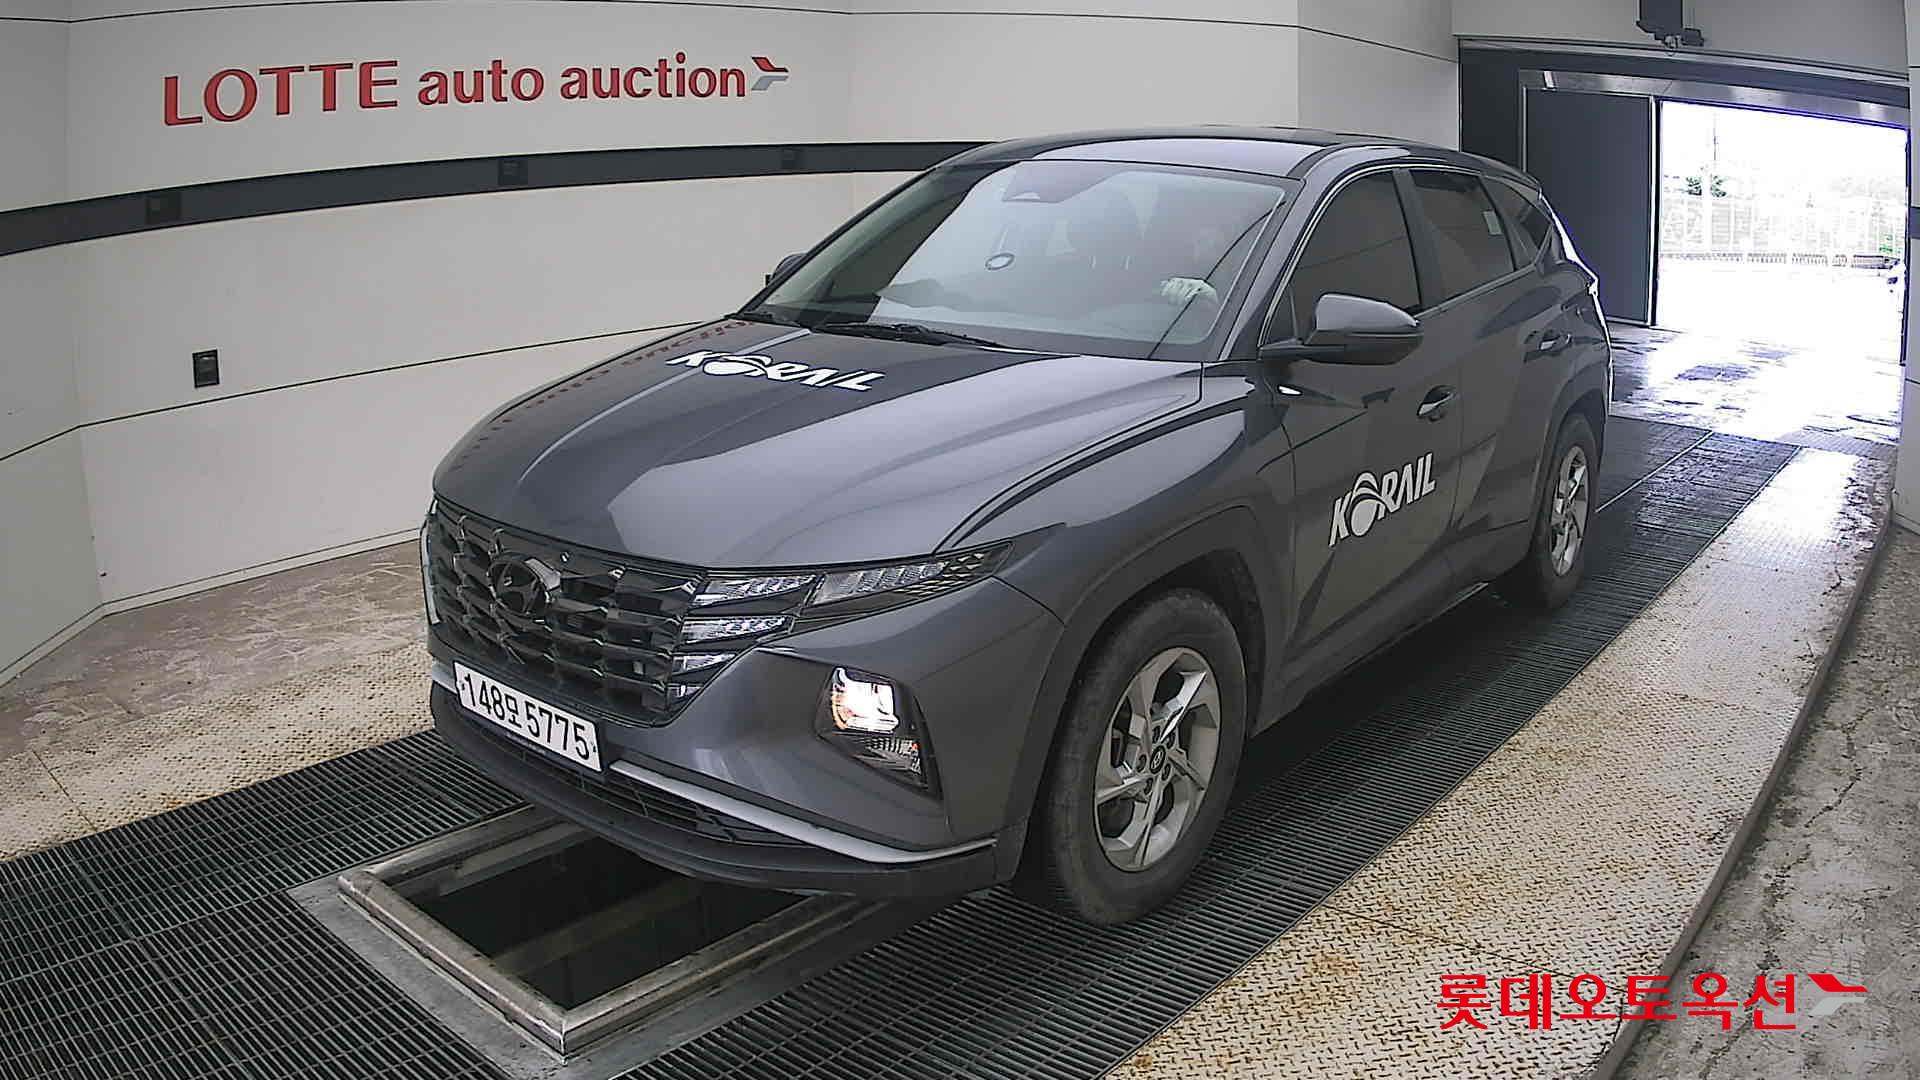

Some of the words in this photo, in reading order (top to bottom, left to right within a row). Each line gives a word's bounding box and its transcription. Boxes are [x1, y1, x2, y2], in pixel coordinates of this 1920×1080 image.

[164, 60, 397, 126] LOTTE
[417, 59, 544, 106] auto
[560, 51, 745, 99] auction
[666, 351, 884, 391] KORAIL
[1329, 452, 1436, 546] KORAIL
